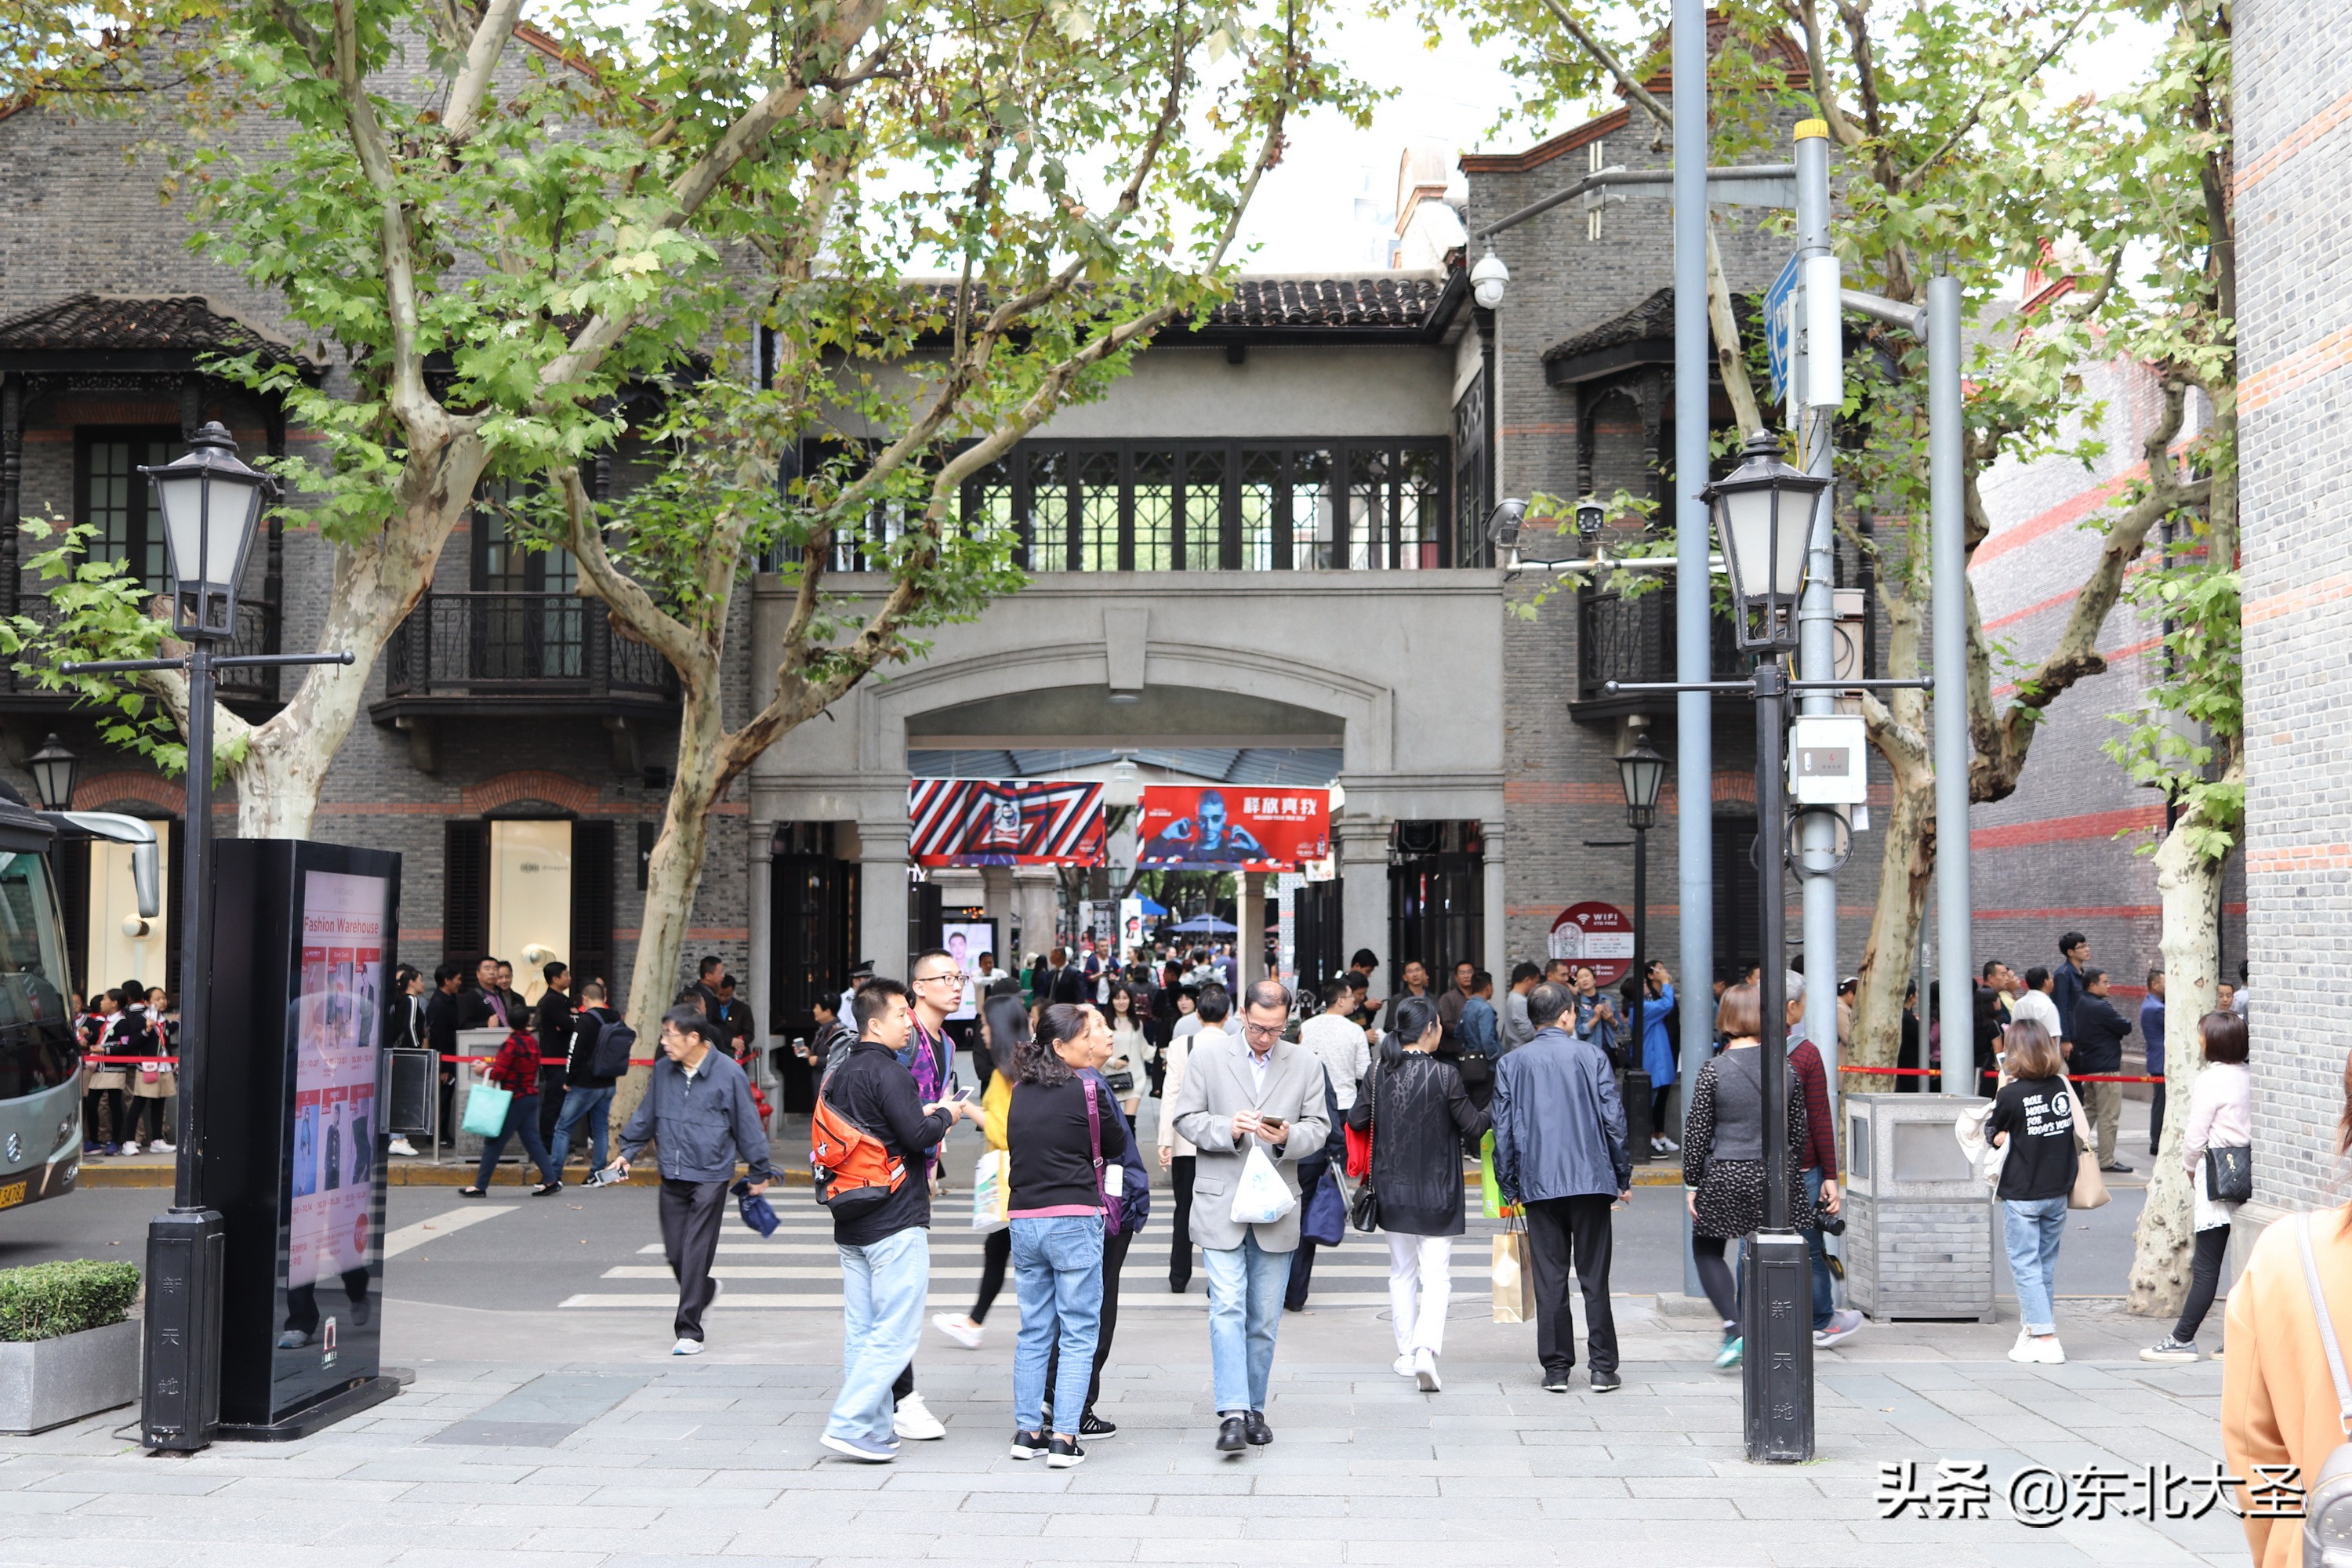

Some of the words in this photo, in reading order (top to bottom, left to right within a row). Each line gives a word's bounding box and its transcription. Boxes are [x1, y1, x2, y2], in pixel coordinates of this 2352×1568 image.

[1243, 797, 1317, 815] 释放真我
[304, 916, 334, 932] Fashion
[337, 917, 379, 935] Warehouse
[2023, 1094, 2043, 1107] ROLE
[2025, 1103, 2050, 1116] MODEL
[2026, 1115, 2042, 1127] FOR
[2027, 1122, 2055, 1135] TODAY'S
[159, 1277, 182, 1395] 新天地
[1772, 1301, 1795, 1421] 新天地
